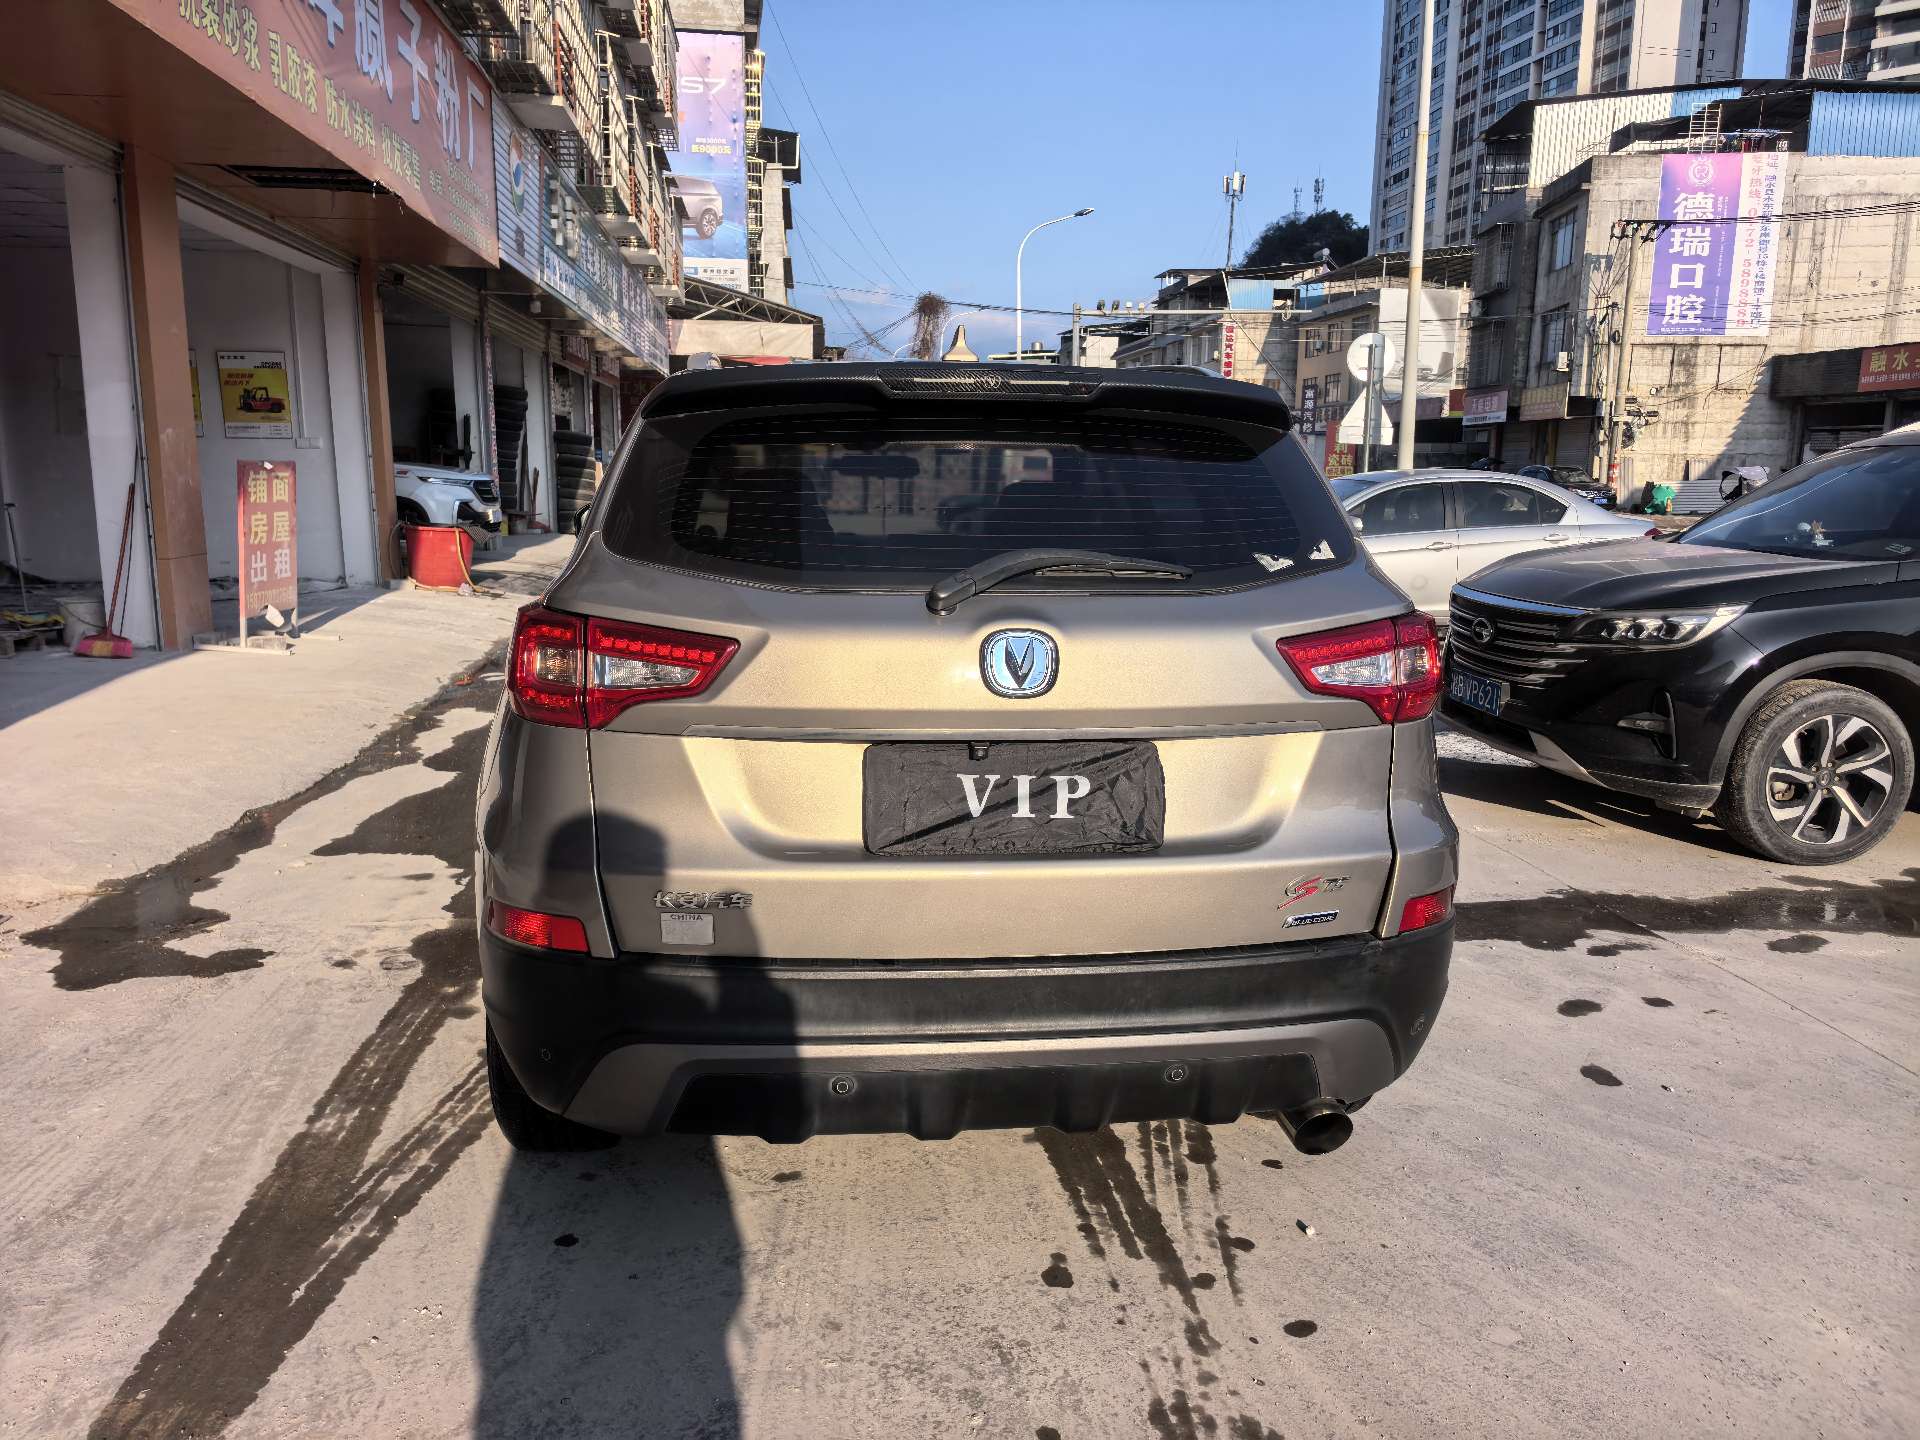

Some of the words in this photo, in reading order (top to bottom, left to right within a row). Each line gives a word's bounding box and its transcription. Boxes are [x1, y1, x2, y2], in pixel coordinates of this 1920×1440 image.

[308, 0, 484, 170] 腻子粉厂
[267, 29, 317, 113] 乳胶漆
[324, 76, 376, 160] 防水涂料
[382, 121, 421, 194] 批发零售
[1662, 191, 1715, 326] 德瑞口腔
[1869, 349, 1920, 373] 融水
[1302, 389, 1315, 433] 富源汽修
[247, 470, 289, 503] 铺面
[249, 511, 290, 545] 房屋
[250, 548, 291, 583] 出租
[956, 773, 1092, 819] VIP
[670, 913, 704, 921] CHINA
